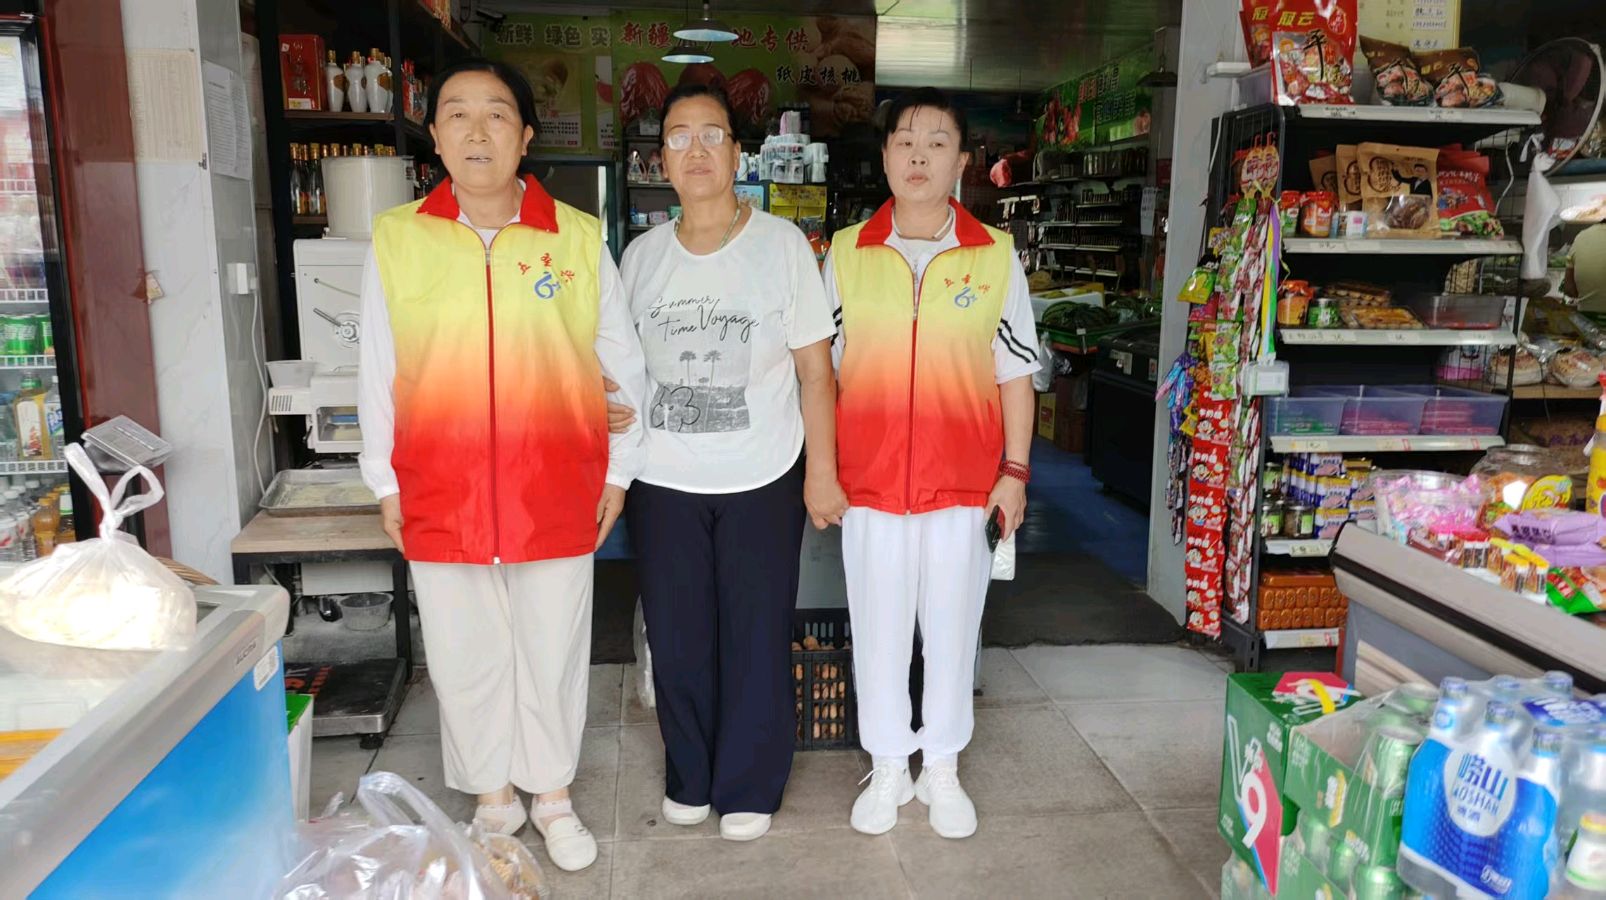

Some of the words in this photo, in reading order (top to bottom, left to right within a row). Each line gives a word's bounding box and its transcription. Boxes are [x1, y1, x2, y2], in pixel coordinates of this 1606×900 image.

[496, 23, 534, 46] 新鲜
[544, 24, 582, 47] 绿色
[620, 22, 811, 53] 新疆地专供
[776, 64, 864, 88] 纸皮核桃
[698, 298, 760, 343] Voyage
